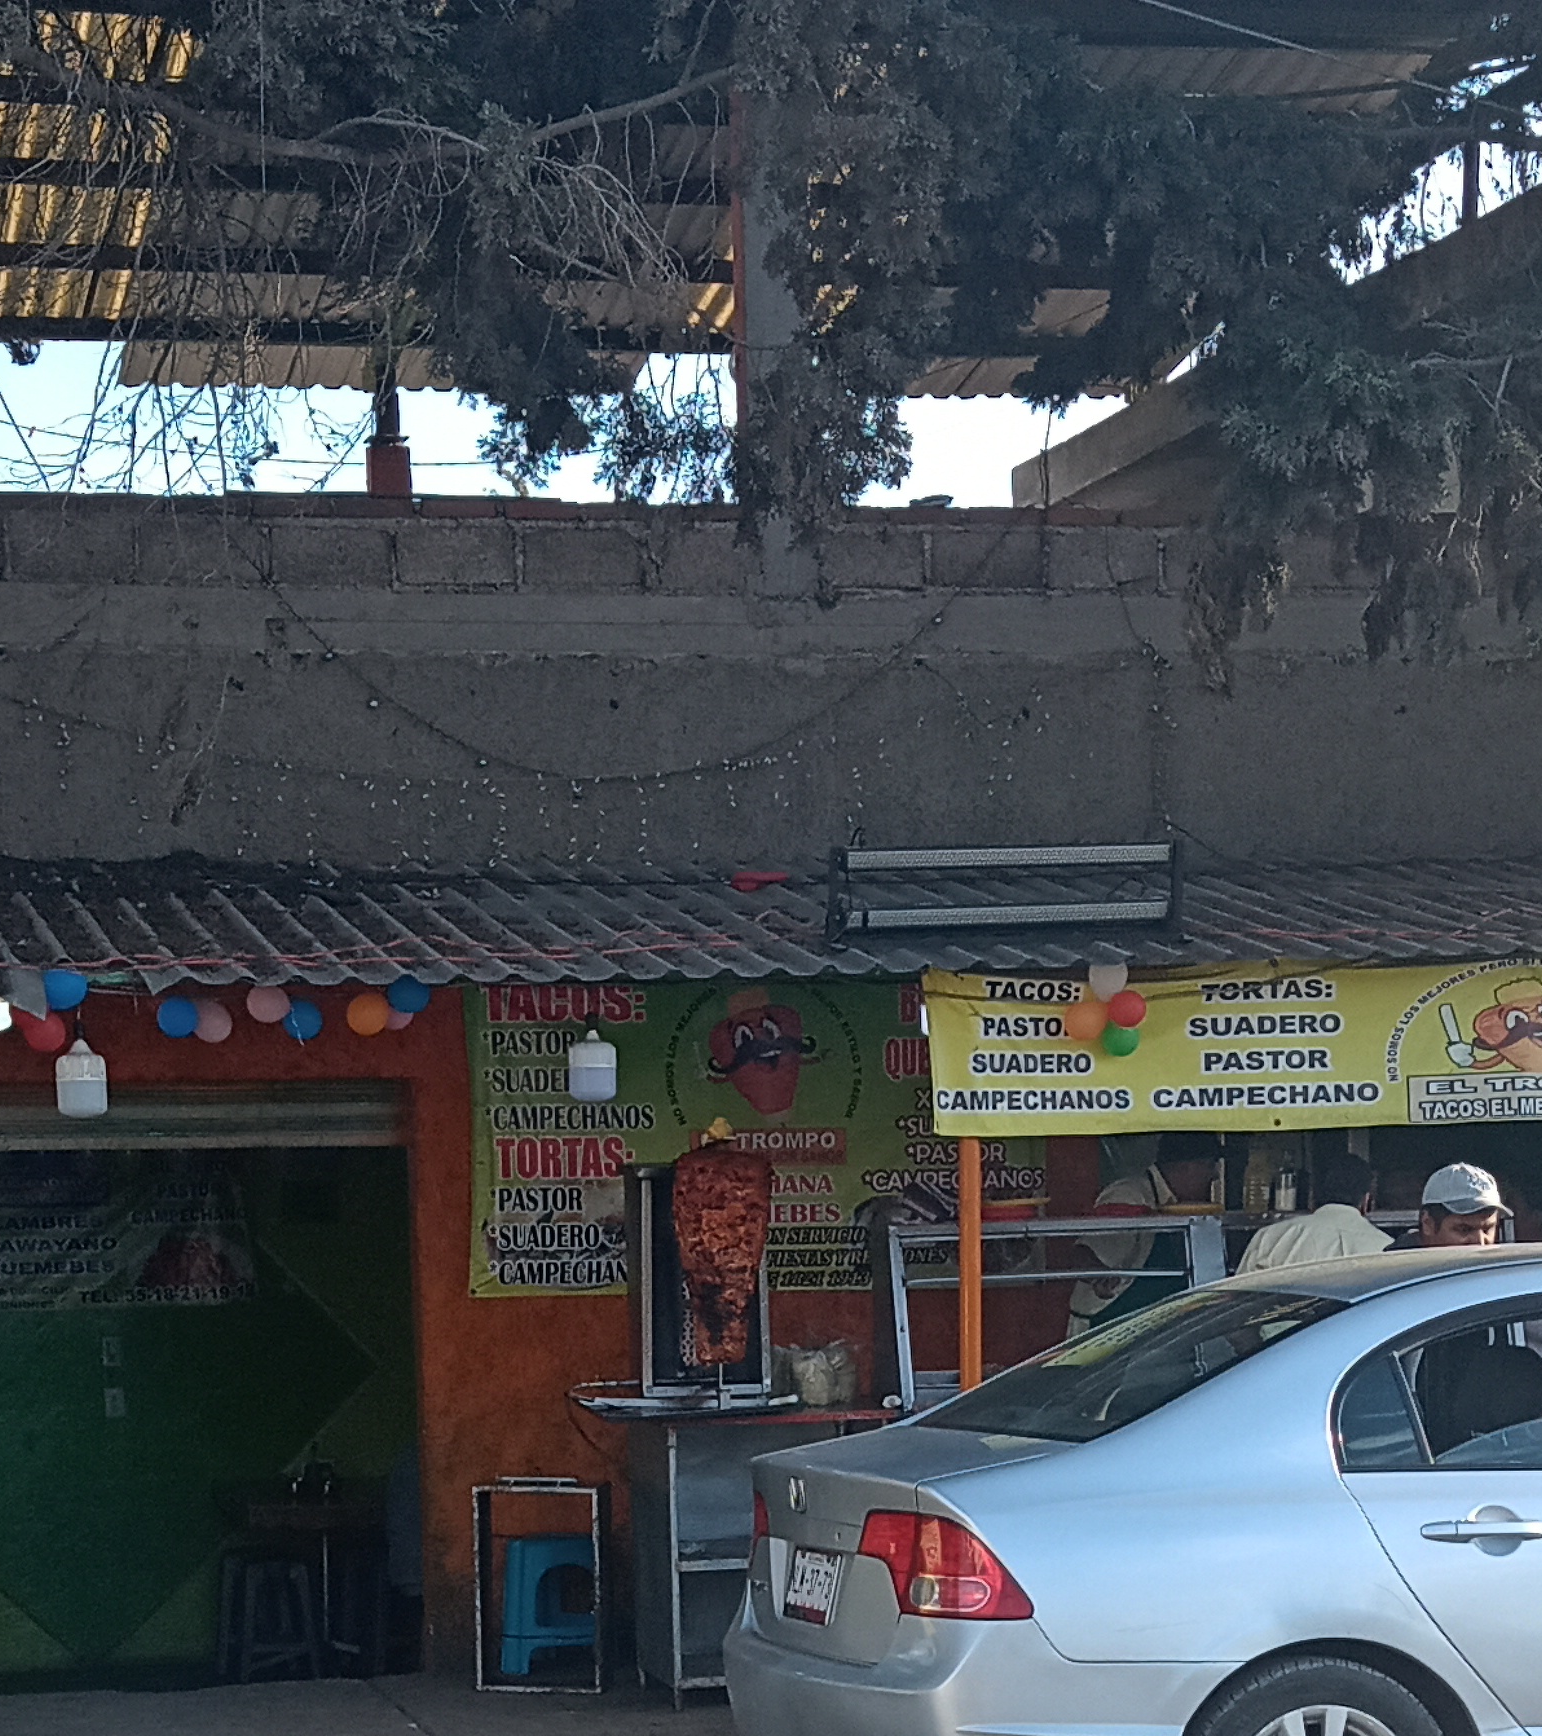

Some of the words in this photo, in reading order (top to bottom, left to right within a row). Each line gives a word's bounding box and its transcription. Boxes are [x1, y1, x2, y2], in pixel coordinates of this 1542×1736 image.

[1479, 958, 1517, 973] PERO
[985, 980, 1081, 1001] TACOS:
[1200, 978, 1334, 1003] TORTAS:
[1417, 968, 1476, 1006] MEJORES
[479, 982, 647, 1024] TACOS:
[981, 1016, 1070, 1038] PASTO
[1187, 1013, 1342, 1037] SUADERO
[1400, 1005, 1418, 1027] LOS
[1387, 1028, 1405, 1064] SOMOS
[971, 1053, 1093, 1075] SUADERO
[1203, 1049, 1329, 1072] PASTOR
[484, 1066, 570, 1094] SUADE
[1387, 1065, 1398, 1081] NO
[1152, 1082, 1380, 1109] CAMPECHANO
[1426, 1081, 1477, 1095] EL
[936, 1088, 1132, 1112] CAMPECHANOS
[1421, 1100, 1488, 1120] TACOS
[1491, 1100, 1519, 1118] EL
[735, 1131, 837, 1150] TROMPO
[905, 1141, 1007, 1164] PASOR
[787, 1225, 868, 1245] SERVICIO
[488, 1259, 628, 1286] CAMPECHAN
